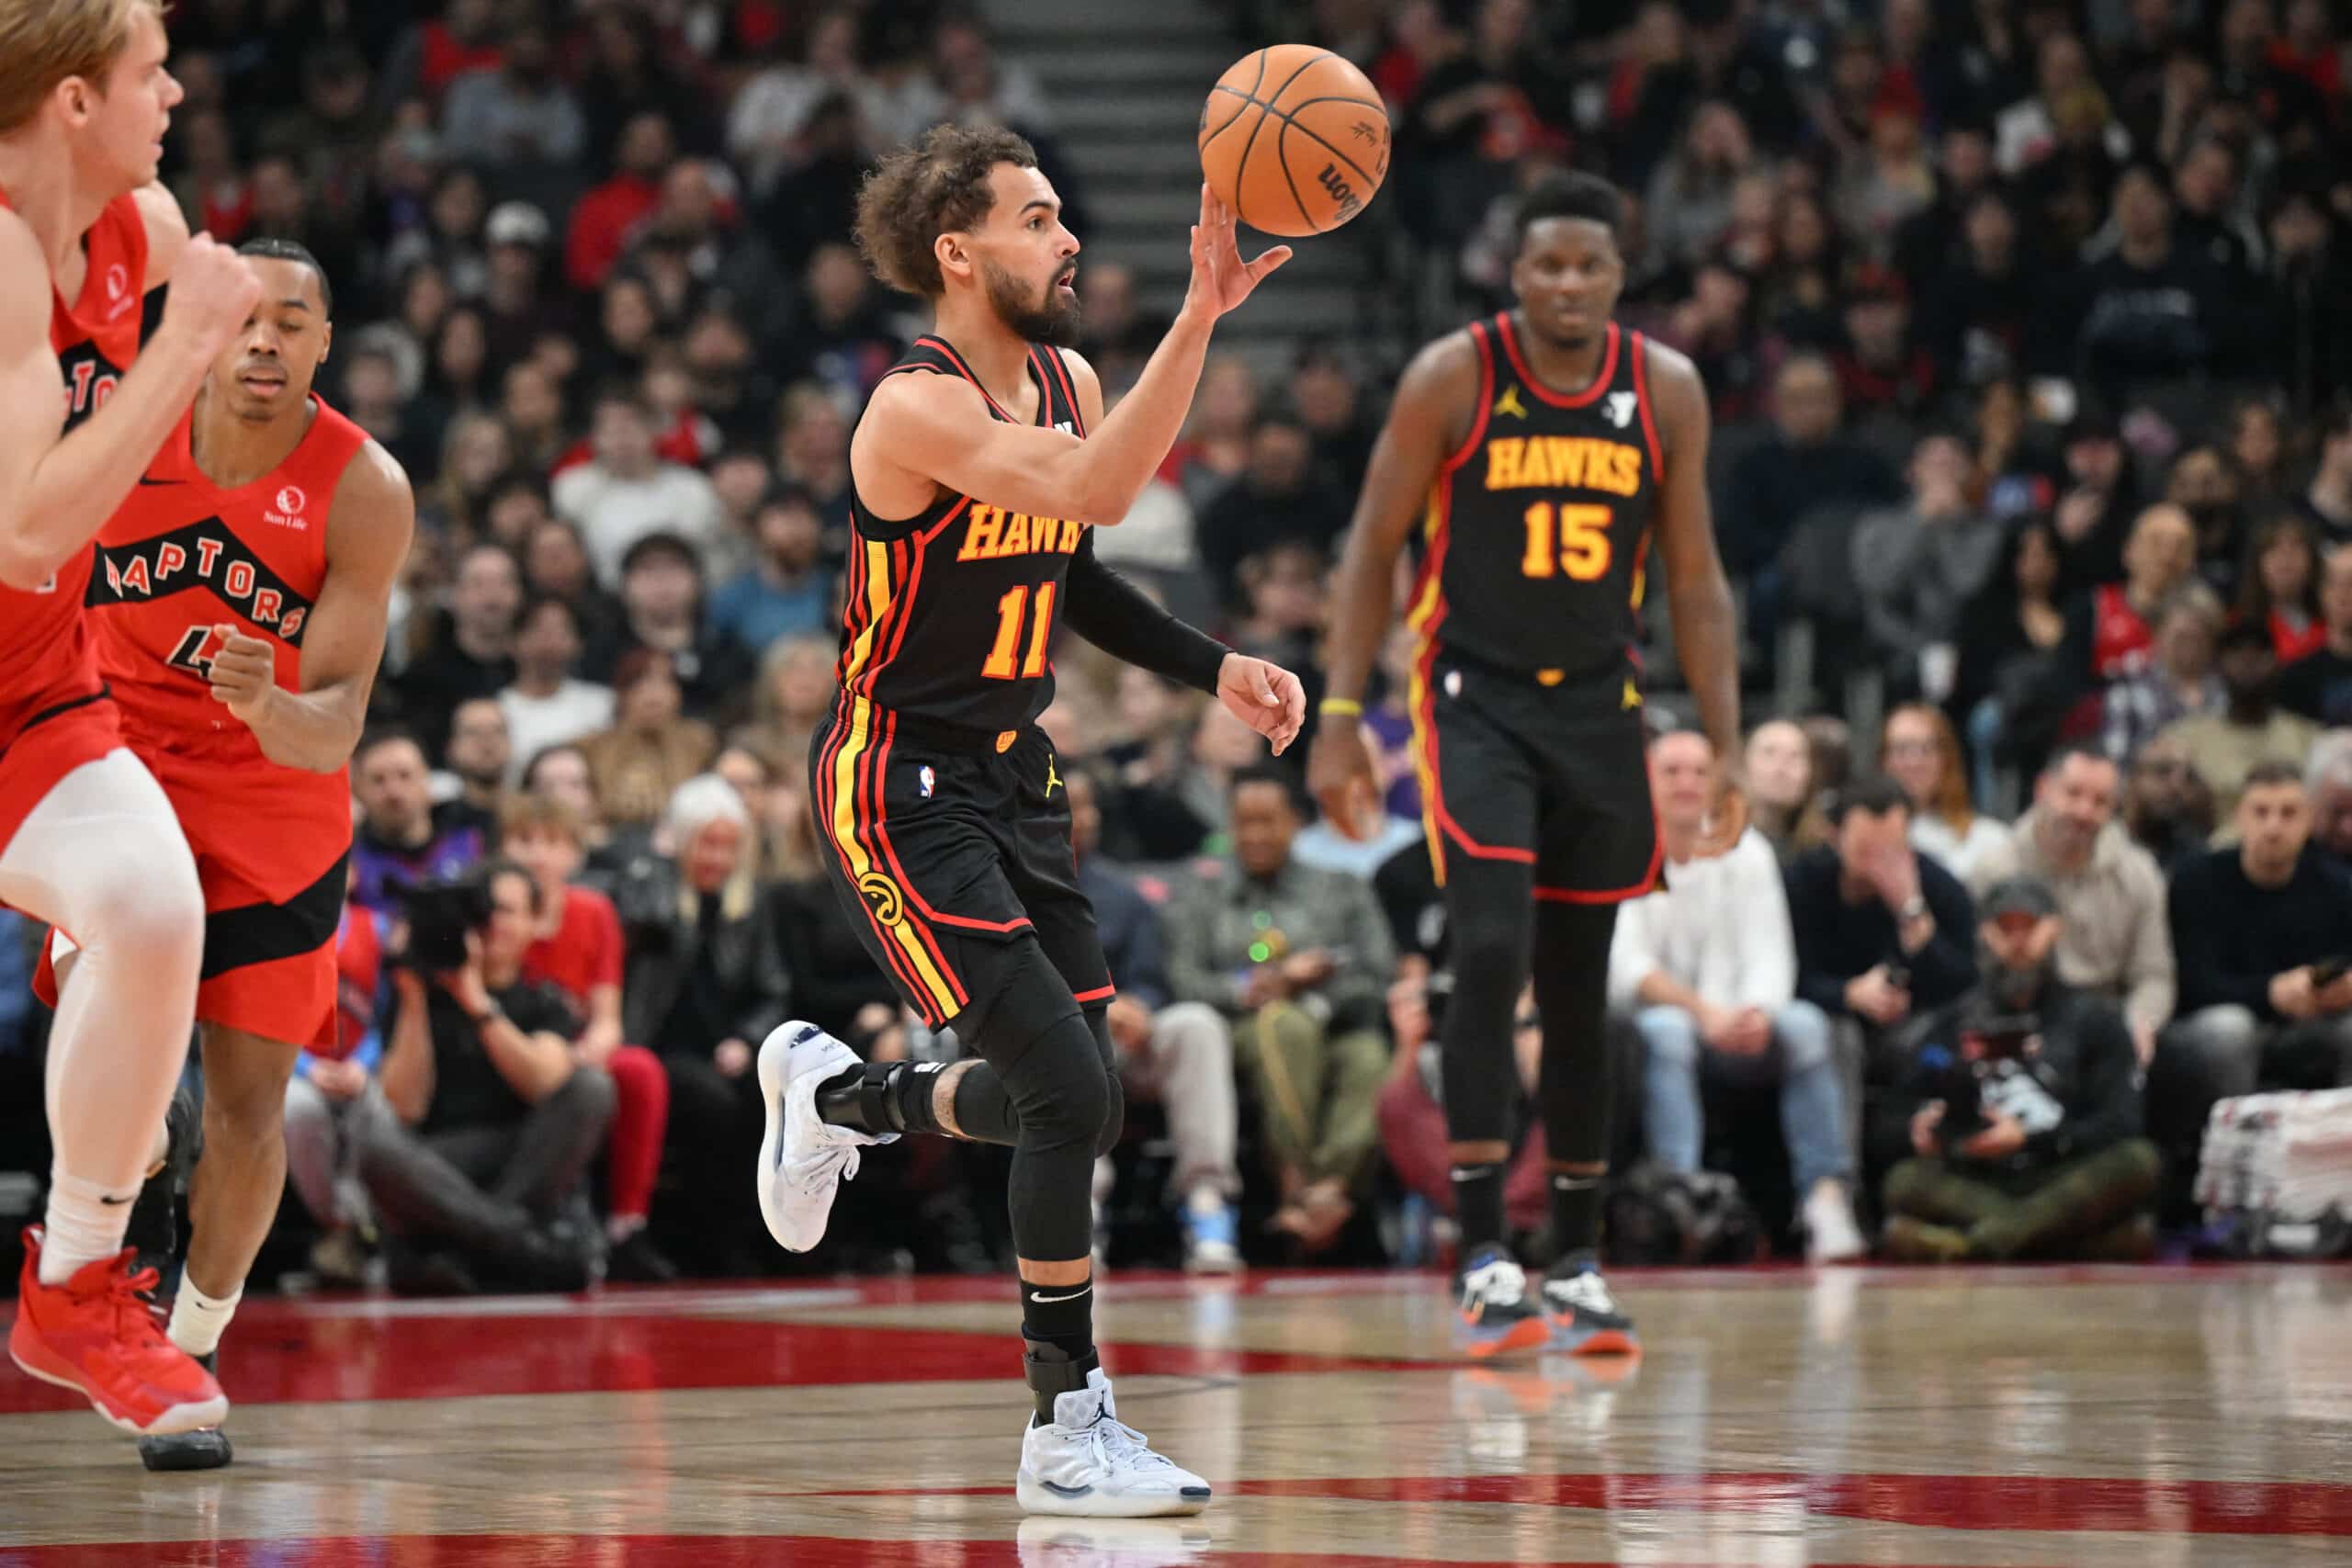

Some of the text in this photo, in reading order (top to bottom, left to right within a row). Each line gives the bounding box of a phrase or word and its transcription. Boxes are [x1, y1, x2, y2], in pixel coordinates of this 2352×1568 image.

[1485, 434, 1642, 497] HAWKS
[264, 510, 308, 530] Sun Life
[1521, 501, 1613, 582] 15
[980, 581, 1057, 680] 11
